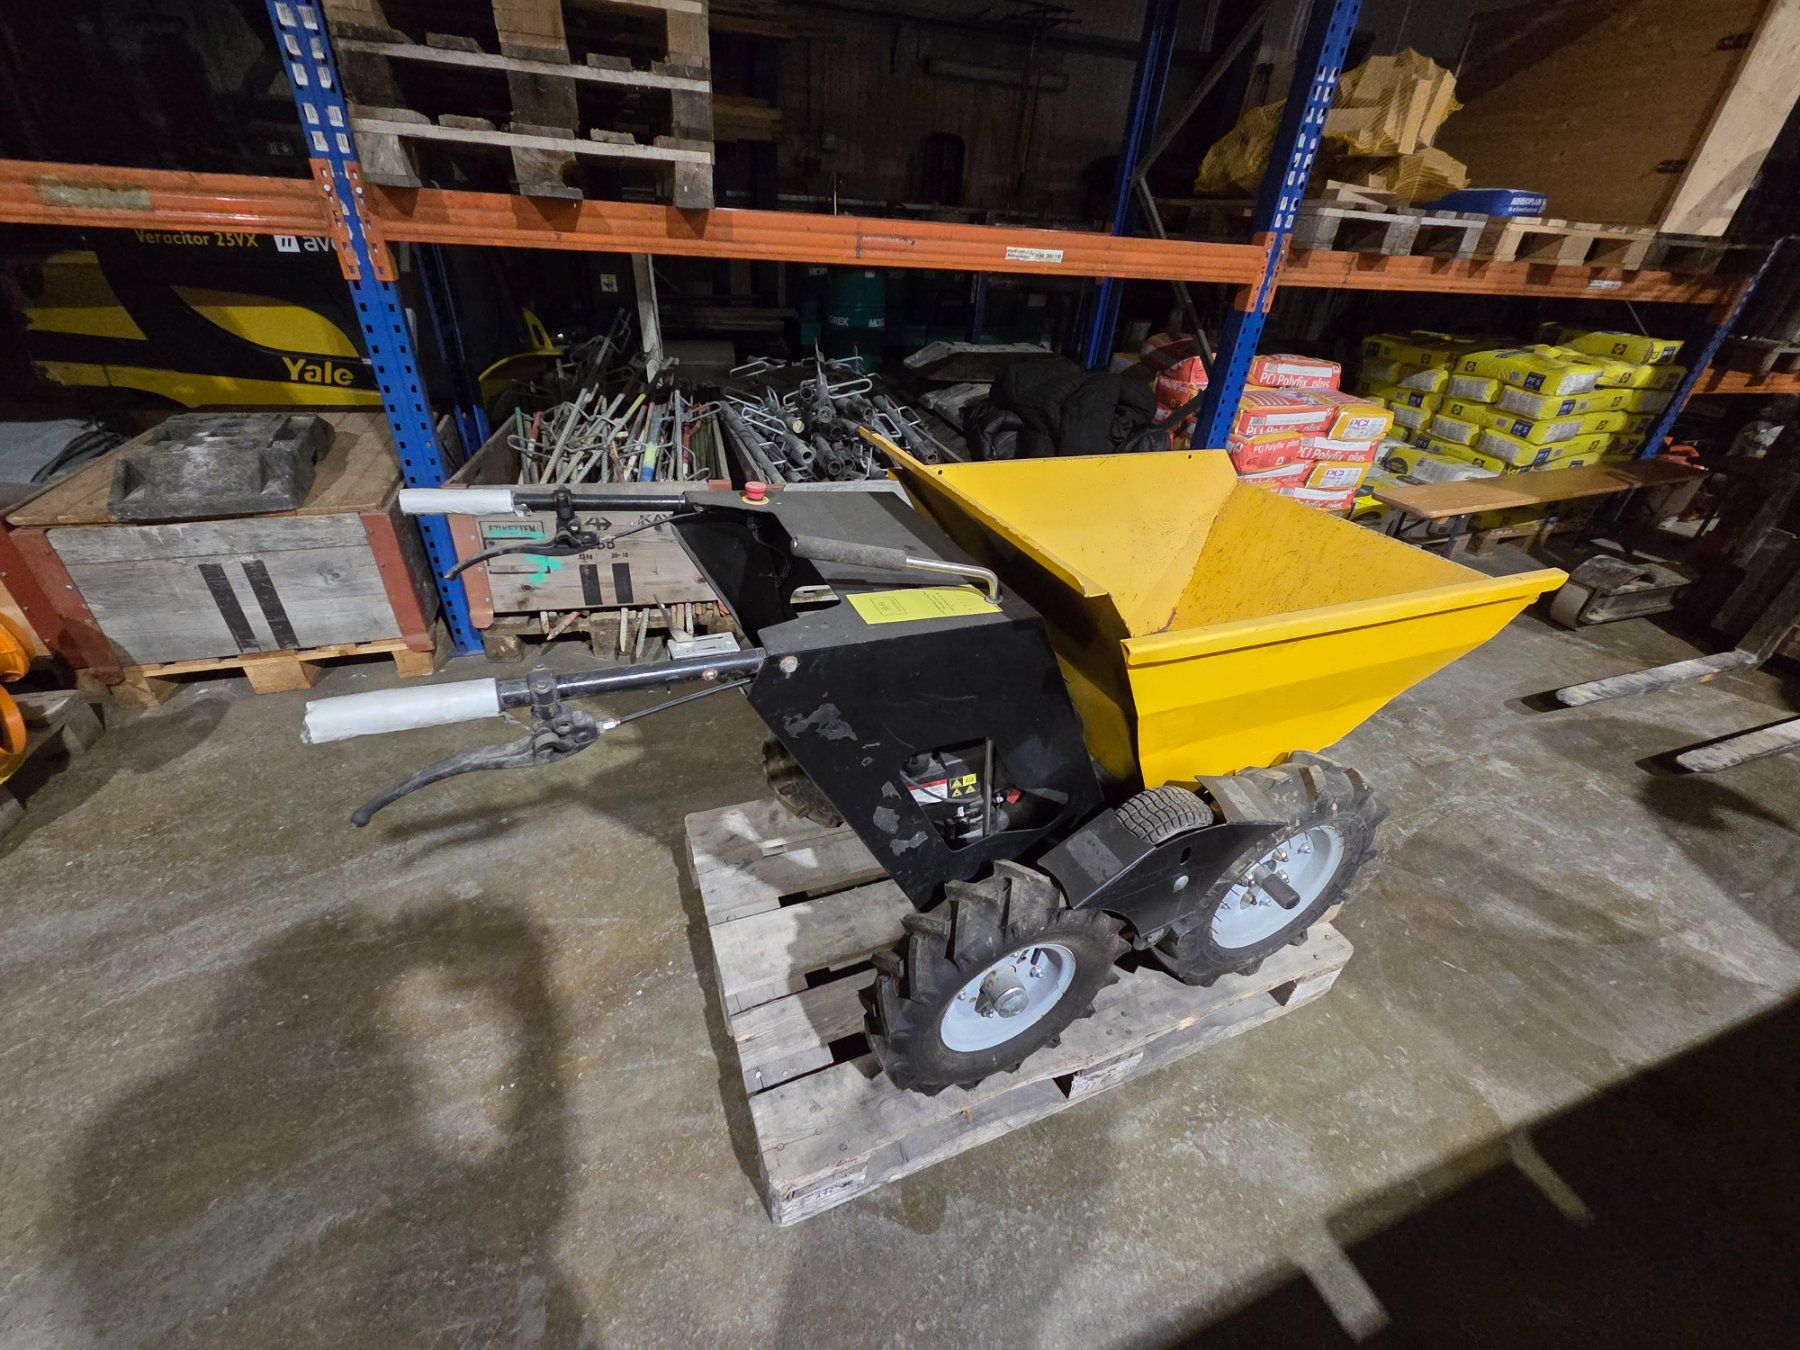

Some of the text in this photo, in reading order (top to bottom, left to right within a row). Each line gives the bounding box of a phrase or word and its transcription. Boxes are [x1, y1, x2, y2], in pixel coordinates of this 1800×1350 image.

[134, 229, 259, 248] Veracitor 25VX
[281, 357, 354, 386] Yale
[1260, 372, 1331, 389] PCI Polyfix plus
[1264, 442, 1284, 452] Polyfix
[1286, 440, 1300, 449] plus
[1312, 447, 1345, 460] Polyfix
[1347, 452, 1366, 462] plus
